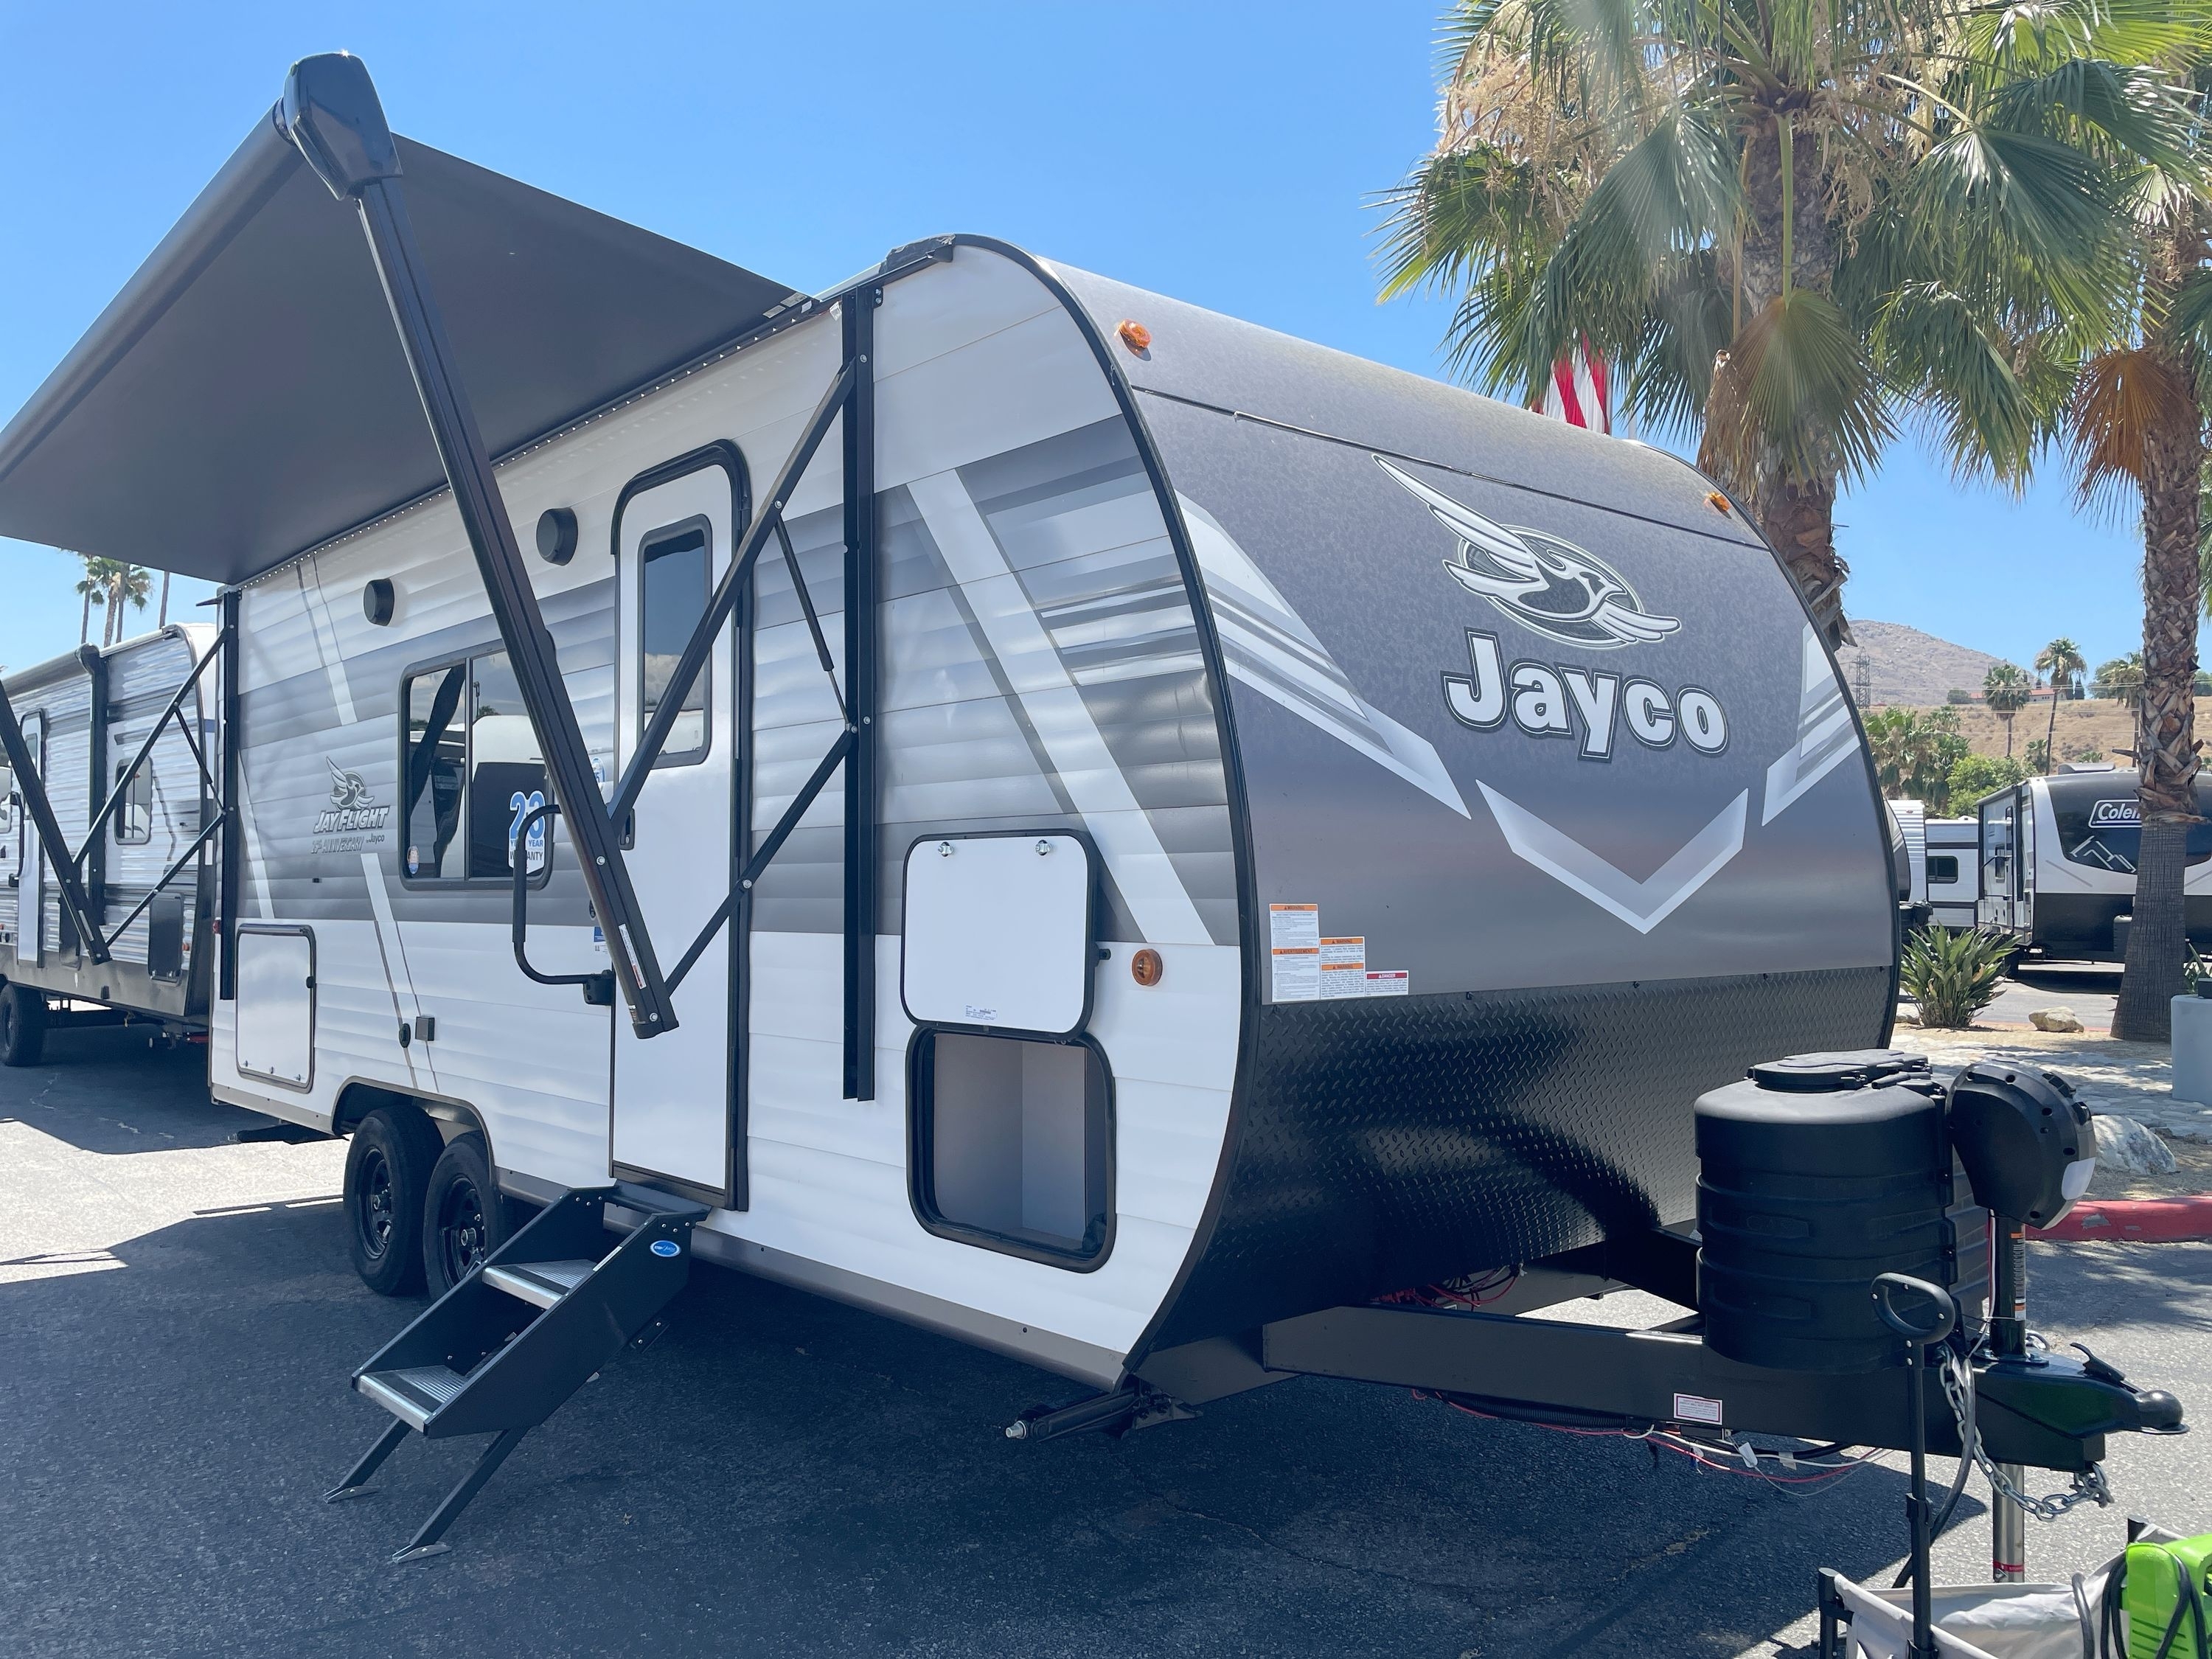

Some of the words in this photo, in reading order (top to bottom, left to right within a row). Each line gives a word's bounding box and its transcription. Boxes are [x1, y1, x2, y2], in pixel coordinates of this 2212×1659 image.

[1441, 627, 1728, 762] Jayco
[313, 810, 341, 834] JAY
[337, 805, 390, 831] FLIGHT
[2098, 803, 2140, 820] Cole
[369, 833, 385, 844] Jayco
[509, 851, 543, 861] WANTY
